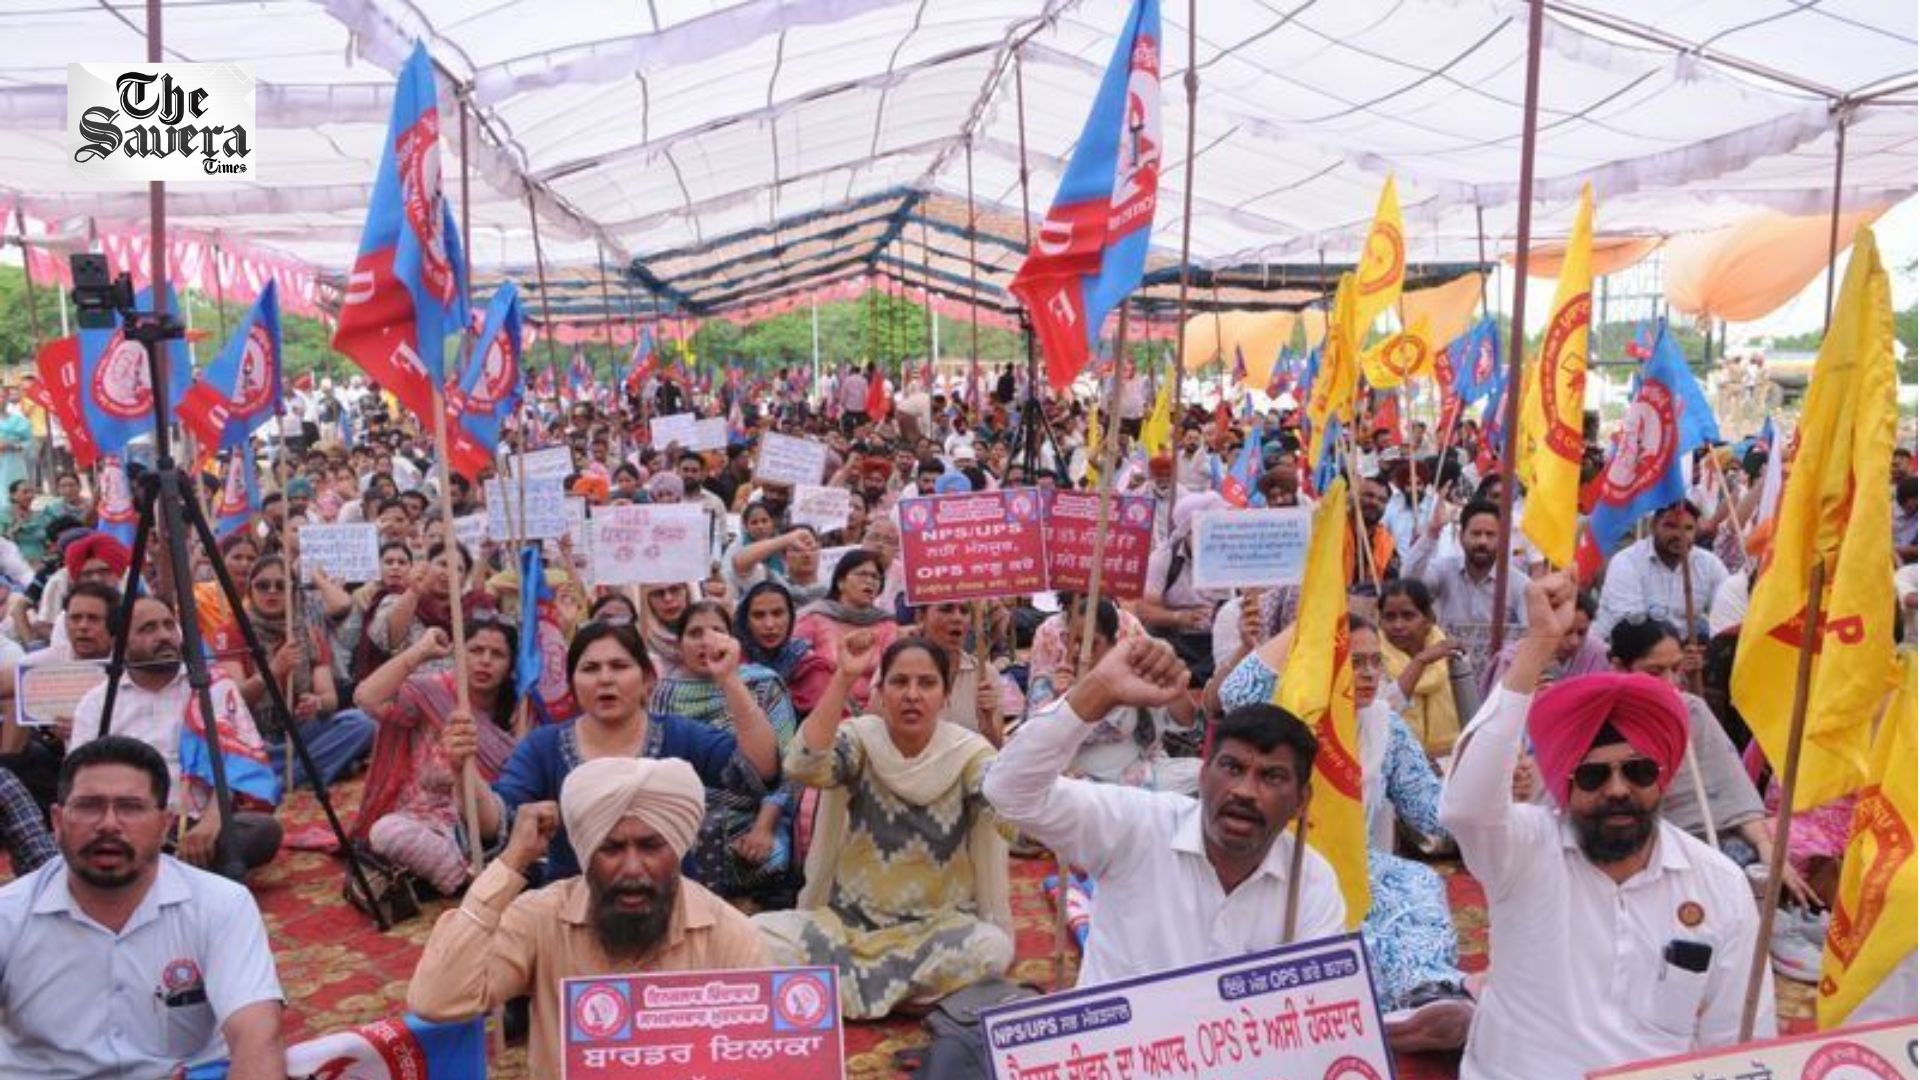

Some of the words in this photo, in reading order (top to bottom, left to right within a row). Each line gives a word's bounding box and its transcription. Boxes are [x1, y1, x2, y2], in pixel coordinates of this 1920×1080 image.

[922, 522, 1023, 542] NPS/UPS
[916, 564, 964, 579] OPS
[1269, 966, 1300, 989] OPS
[994, 1016, 1059, 1045] NPS/UPS
[1198, 1018, 1242, 1067] OPS
[1241, 1006, 1262, 1058] ਦੇ
[582, 1042, 694, 1068] ਬਾਰਡਰ
[710, 1034, 823, 1063] ਇਲਾਕਾ
